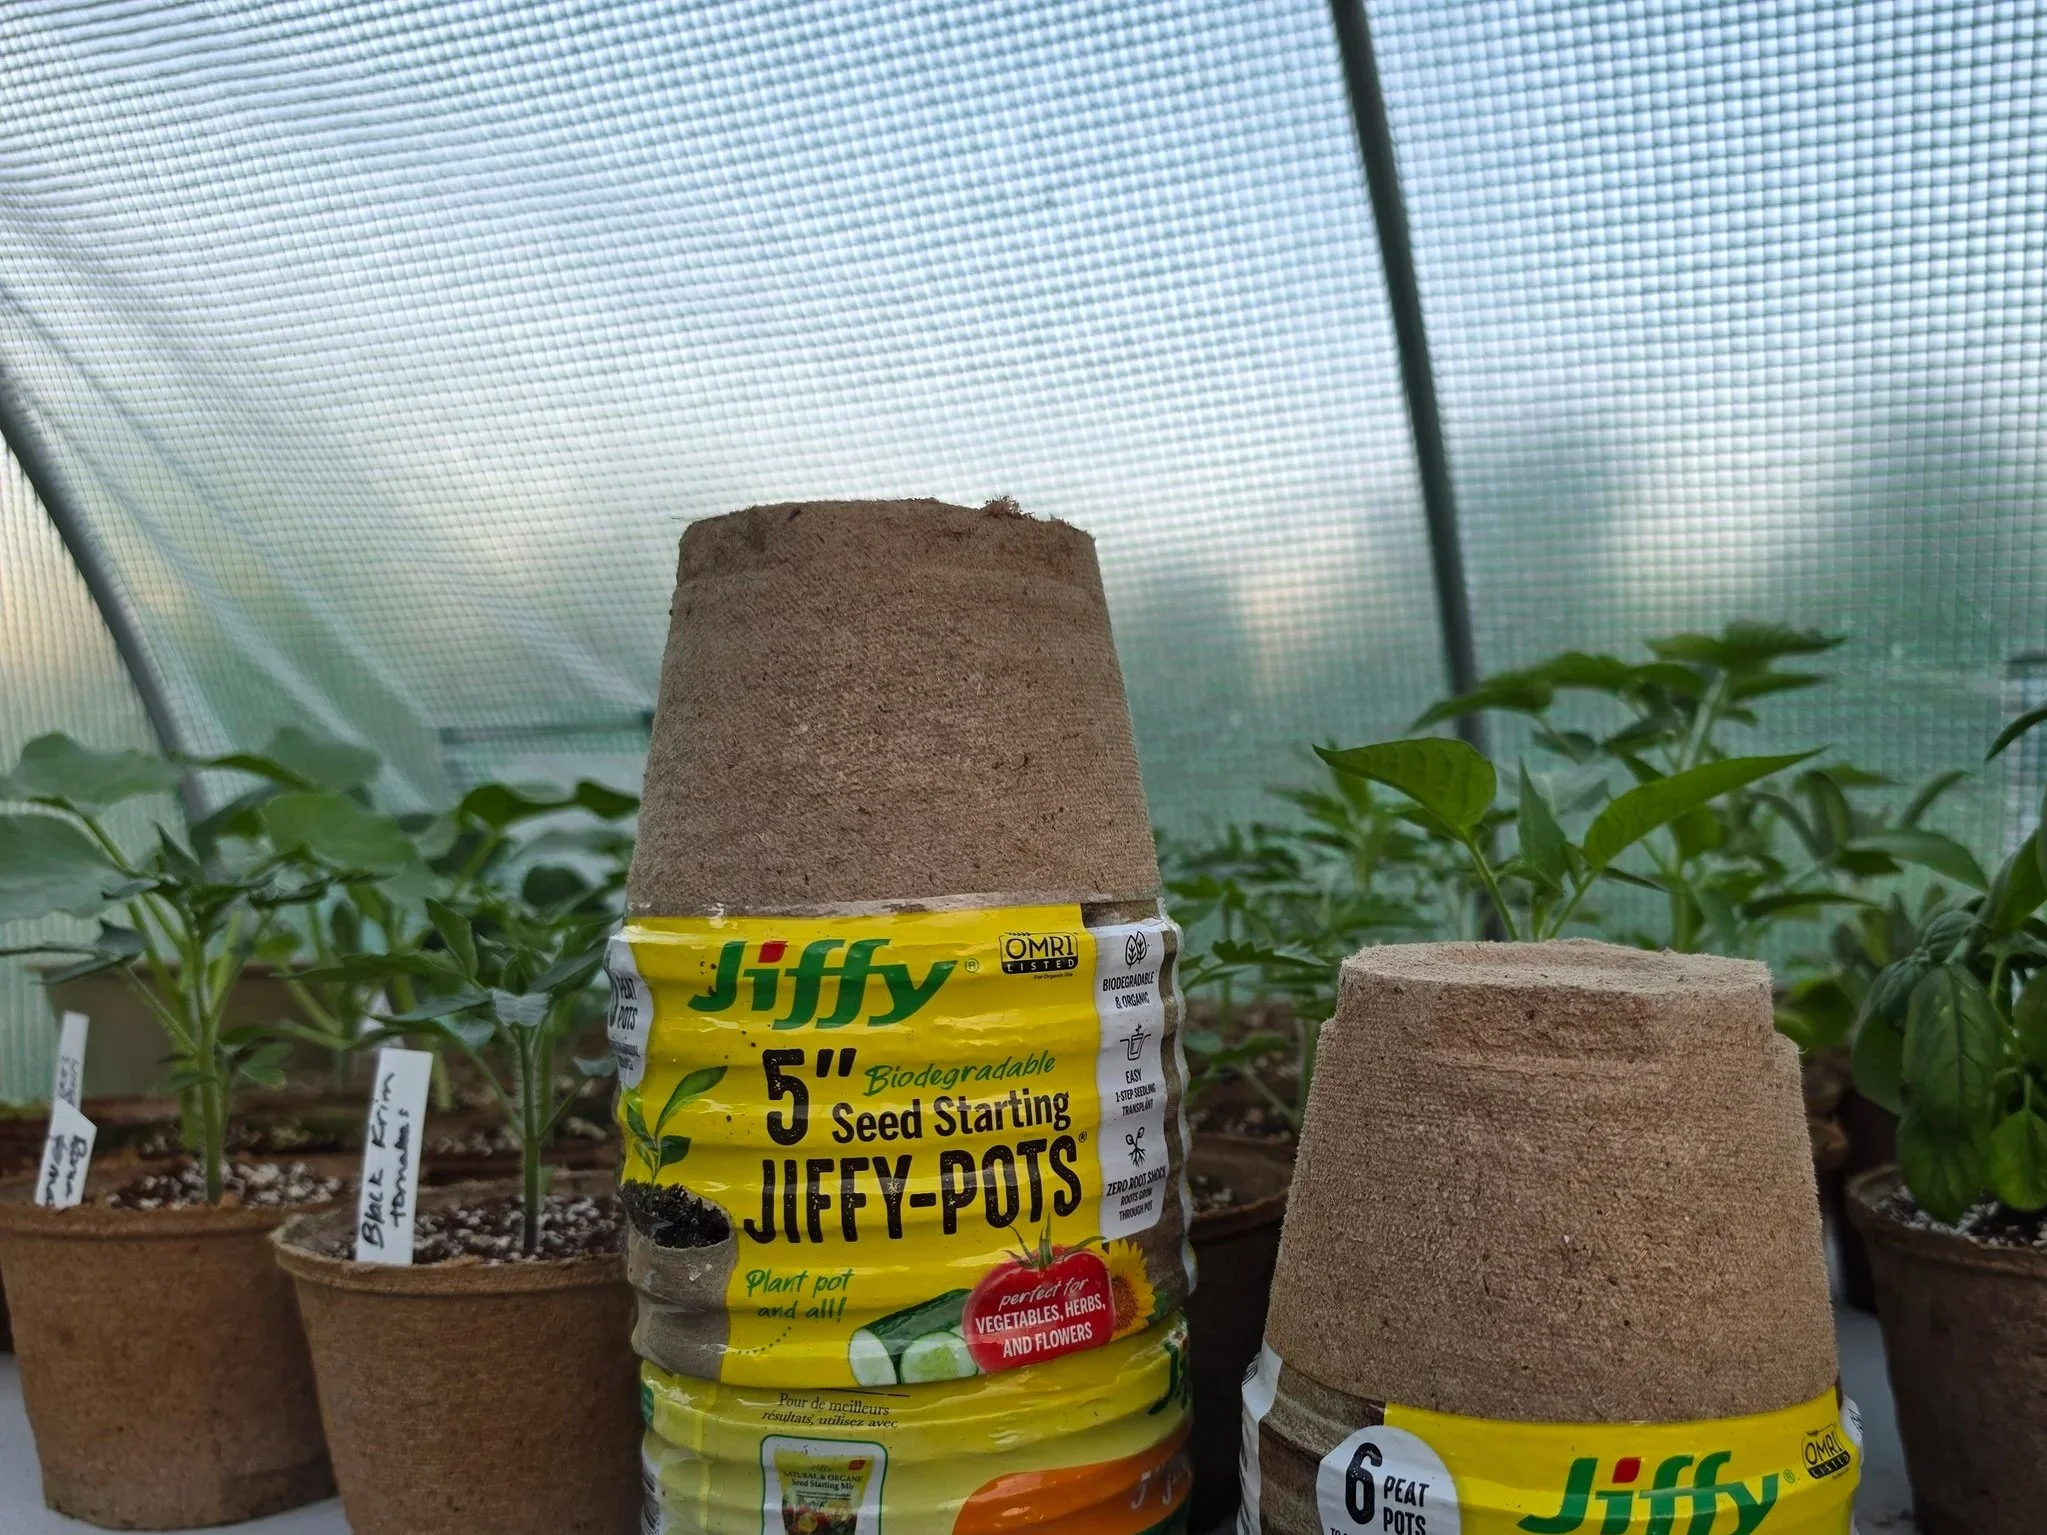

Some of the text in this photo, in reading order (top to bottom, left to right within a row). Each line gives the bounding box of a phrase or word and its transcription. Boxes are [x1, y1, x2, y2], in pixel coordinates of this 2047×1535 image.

[1005, 935, 1075, 960] OMRI
[1006, 958, 1075, 972] LISTED
[687, 939, 958, 1030] Jiffy
[1103, 973, 1154, 991] BIODEGRADABLE
[1115, 992, 1150, 1008] & ORGANIC
[617, 1005, 638, 1031] POTS
[863, 1050, 1056, 1096] Biodegradable
[1125, 1068, 1142, 1084] EASY
[1115, 1083, 1156, 1102] 1-STEP SEEDLING
[832, 1088, 1072, 1144] Seed Starting
[1122, 1098, 1153, 1116] TRANSPLANT
[743, 1136, 1082, 1244] JIFFY-POTS
[1106, 1165, 1167, 1196] ZERO ROOT SHOCK
[361, 1169, 385, 1249] Black
[1120, 1187, 1153, 1206] ROOTS GROW
[1119, 1200, 1153, 1221] THROUGH POT
[745, 1268, 855, 1298] Plant pot
[998, 1277, 1089, 1311] perfect for
[758, 1296, 847, 1322] and all!
[975, 1293, 1106, 1334] VEGETABLES, HERBS,
[1003, 1322, 1093, 1358] AND FLOWERS
[779, 1392, 889, 1416] Pour de meilleurs
[818, 1414, 864, 1427] utilisez
[868, 1420, 898, 1428] avec
[1804, 1431, 1843, 1465] OMRI
[1811, 1454, 1849, 1477] LISTED
[792, 1478, 808, 1487] Seed
[810, 1479, 839, 1491] Starting
[1345, 1442, 1430, 1525] 6 PEAT
[1516, 1451, 1779, 1535] Jiffy
[1383, 1506, 1426, 1535] POTS
